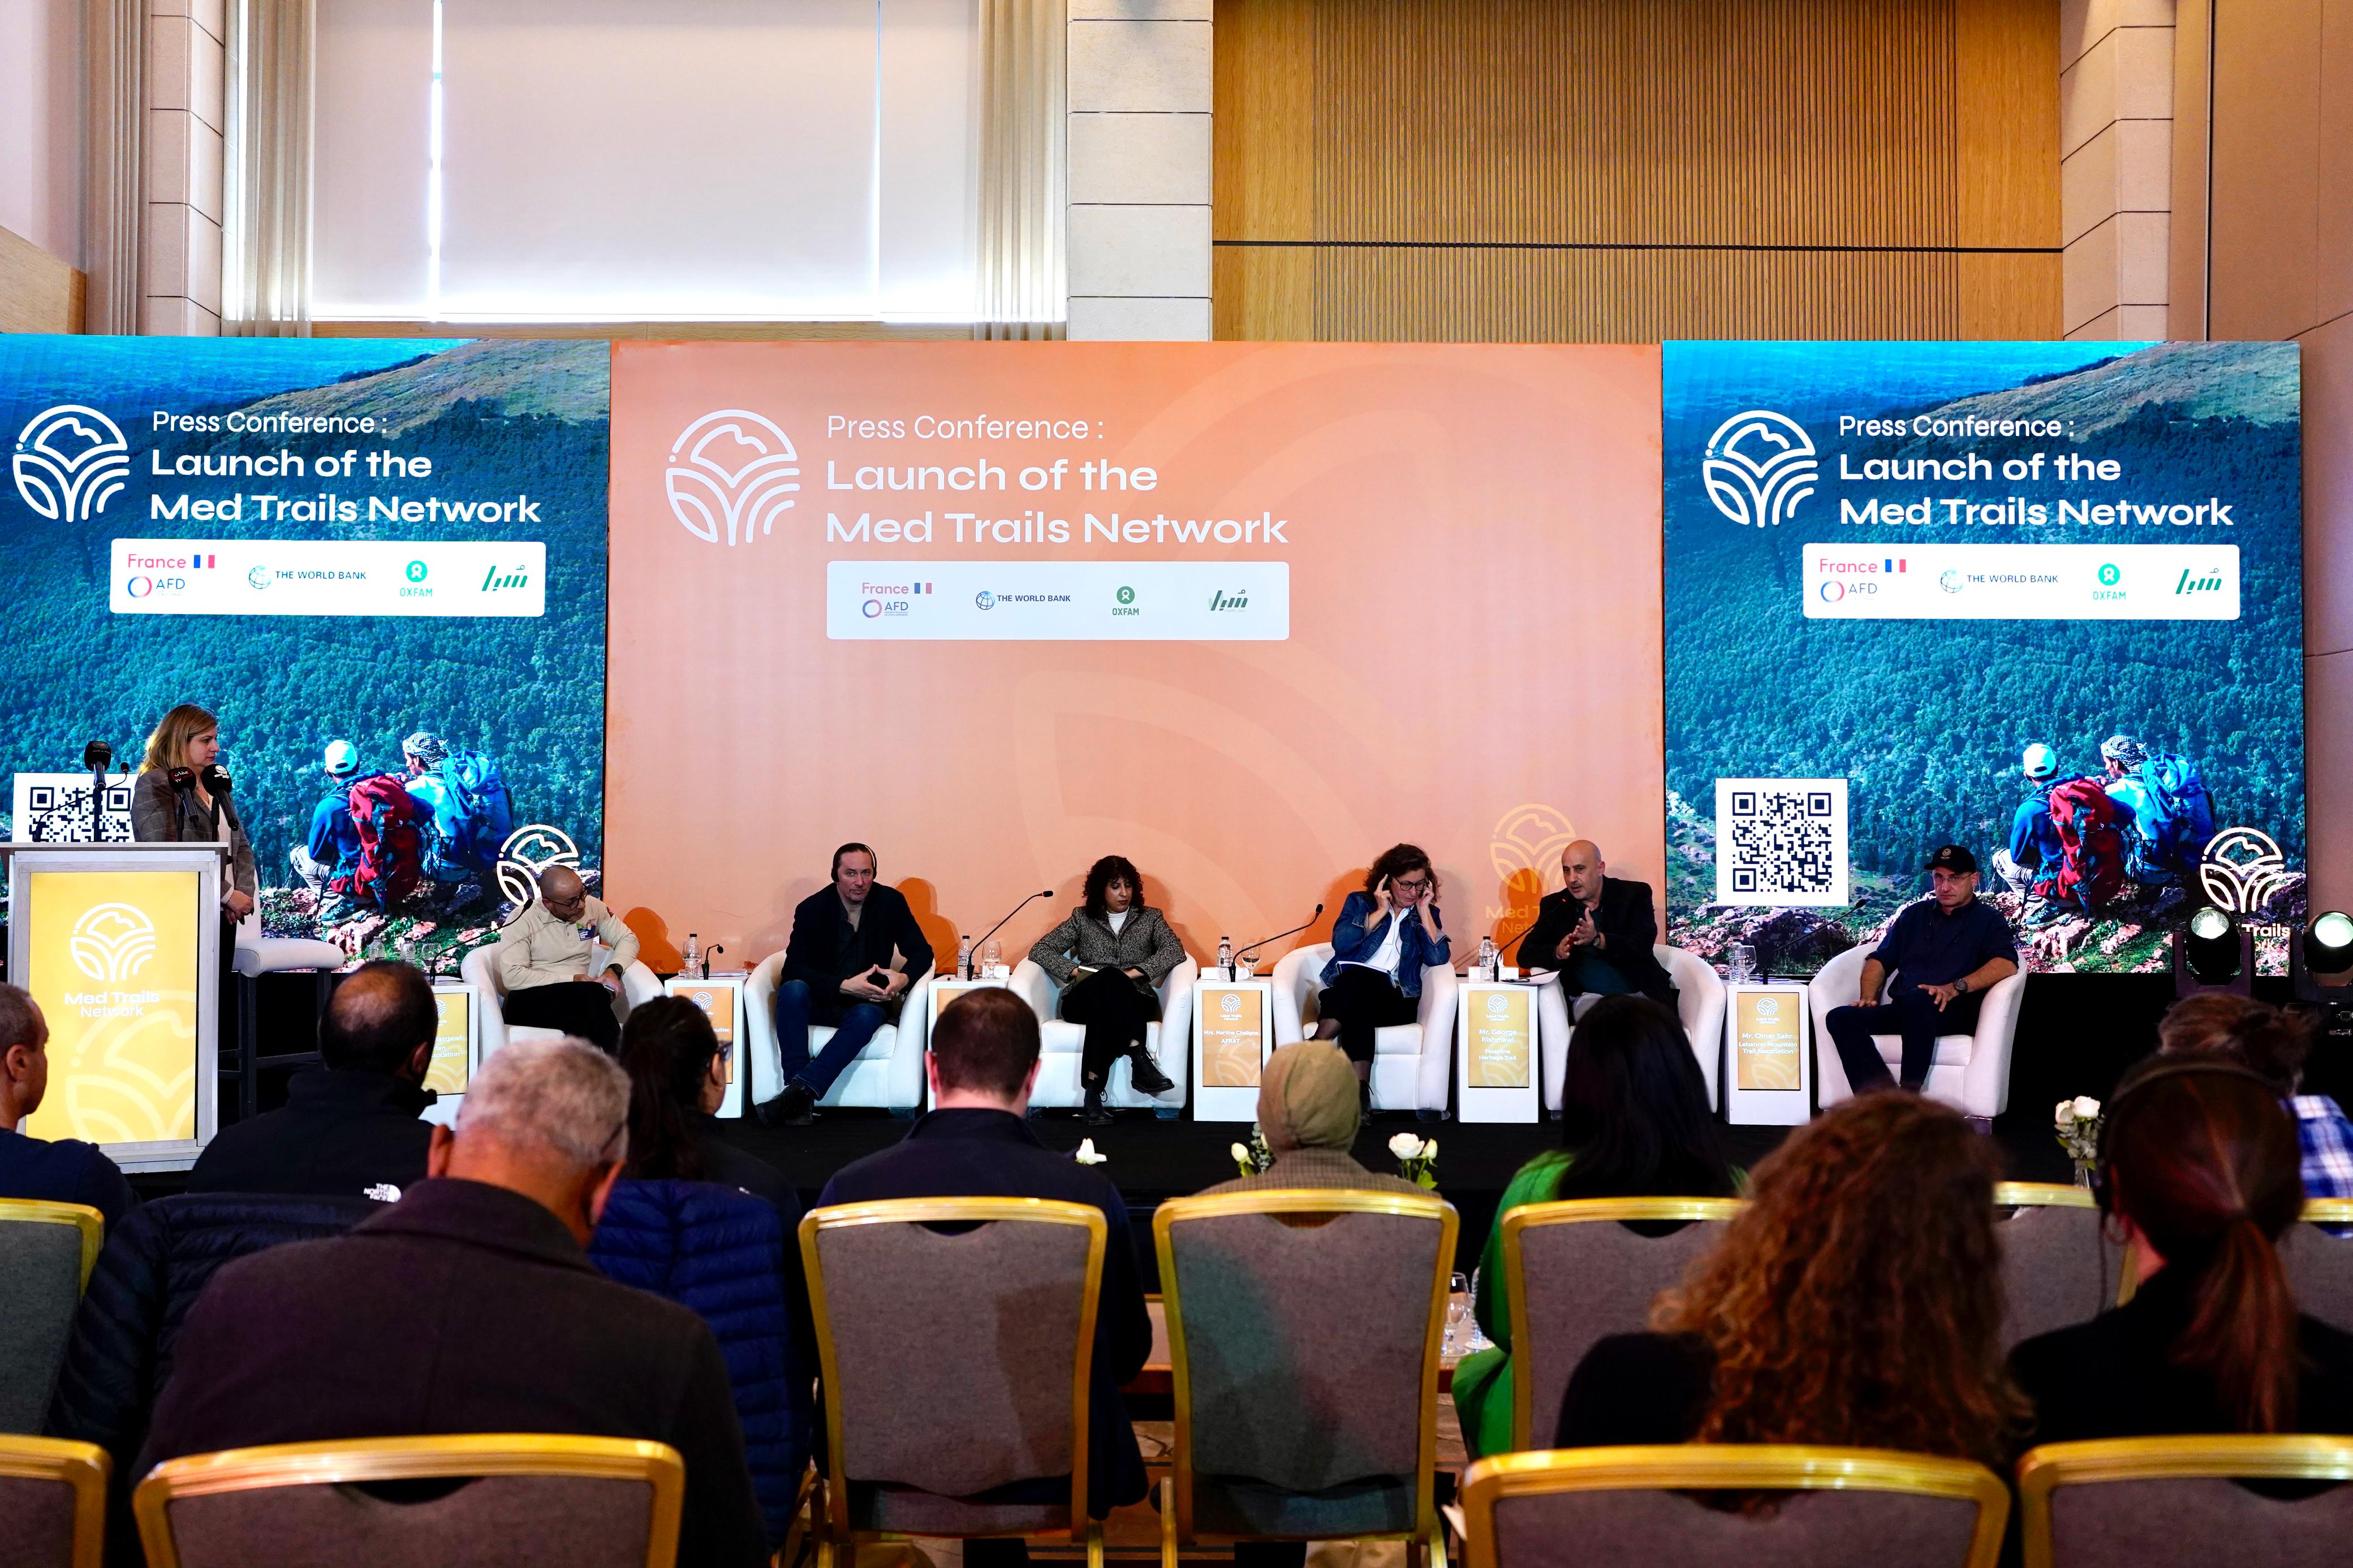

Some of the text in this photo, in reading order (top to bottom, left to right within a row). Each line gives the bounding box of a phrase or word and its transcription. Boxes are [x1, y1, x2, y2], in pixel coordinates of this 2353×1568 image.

[154, 412, 219, 431] Press
[227, 412, 374, 433] Conference
[828, 416, 905, 438] Press
[915, 414, 1088, 439] Conference
[1841, 416, 1906, 435] Press
[1914, 415, 2061, 436] Conference
[153, 450, 431, 477] Launch of the
[1841, 453, 2120, 480] Launch of the
[827, 459, 1157, 490] Launch of the
[152, 494, 541, 522] Med Trails Network
[1841, 497, 2233, 525] Med Trails Network
[826, 511, 1288, 543] Med Trails Network
[128, 554, 186, 568] France
[1820, 559, 1877, 573] France
[275, 570, 294, 579] THE
[298, 571, 335, 579] WORLD
[2031, 574, 2058, 583] BANK
[156, 578, 185, 589] AFD
[863, 582, 909, 594] France
[1848, 583, 1877, 594] AFD
[399, 588, 433, 597] OXFAM
[2093, 591, 2126, 600] OXFAM
[885, 602, 908, 611] AFD
[1485, 905, 1529, 919] Med
[2241, 923, 2290, 937] Trails
[64, 990, 160, 1005] Med Trails
[81, 1004, 144, 1018] Network
